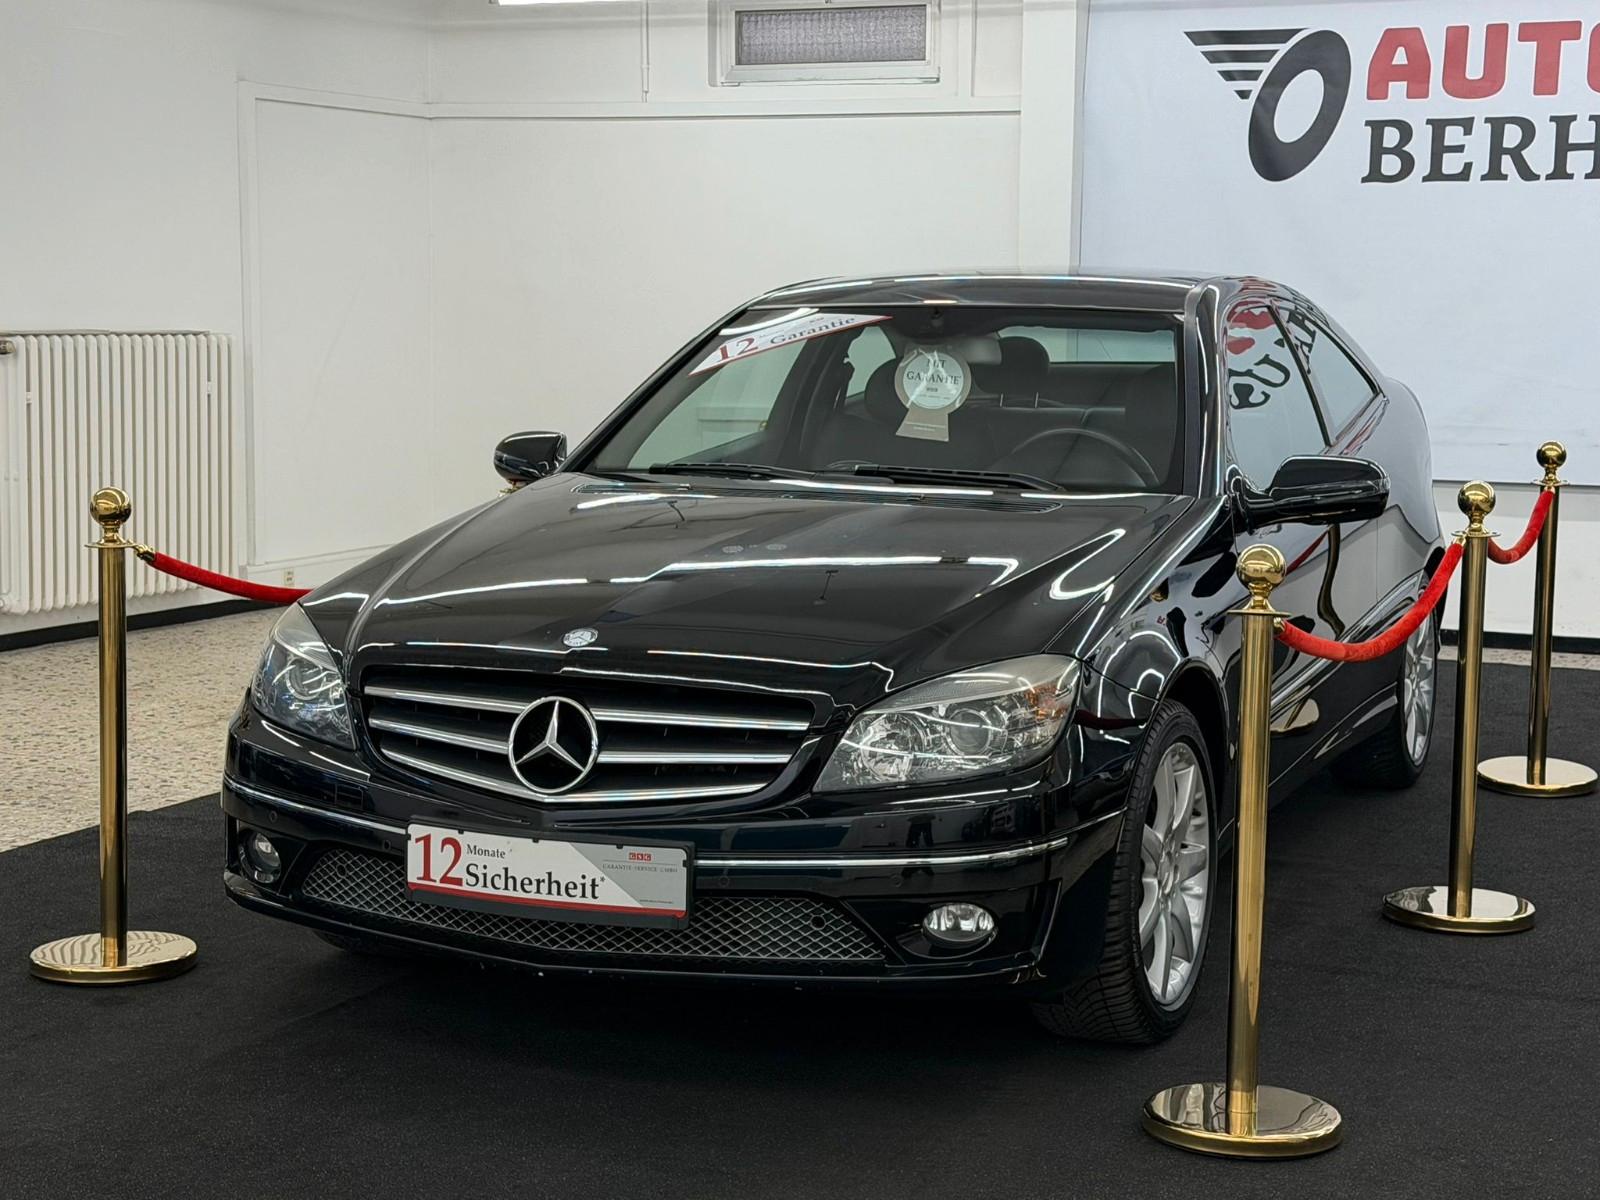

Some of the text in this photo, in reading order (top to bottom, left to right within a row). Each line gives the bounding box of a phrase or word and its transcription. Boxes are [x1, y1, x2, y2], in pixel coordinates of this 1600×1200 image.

[1366, 20, 1600, 100] AUT
[1360, 114, 1600, 184] BERH
[717, 317, 856, 361] 12 Garantie
[415, 833, 506, 887] 12 Monate
